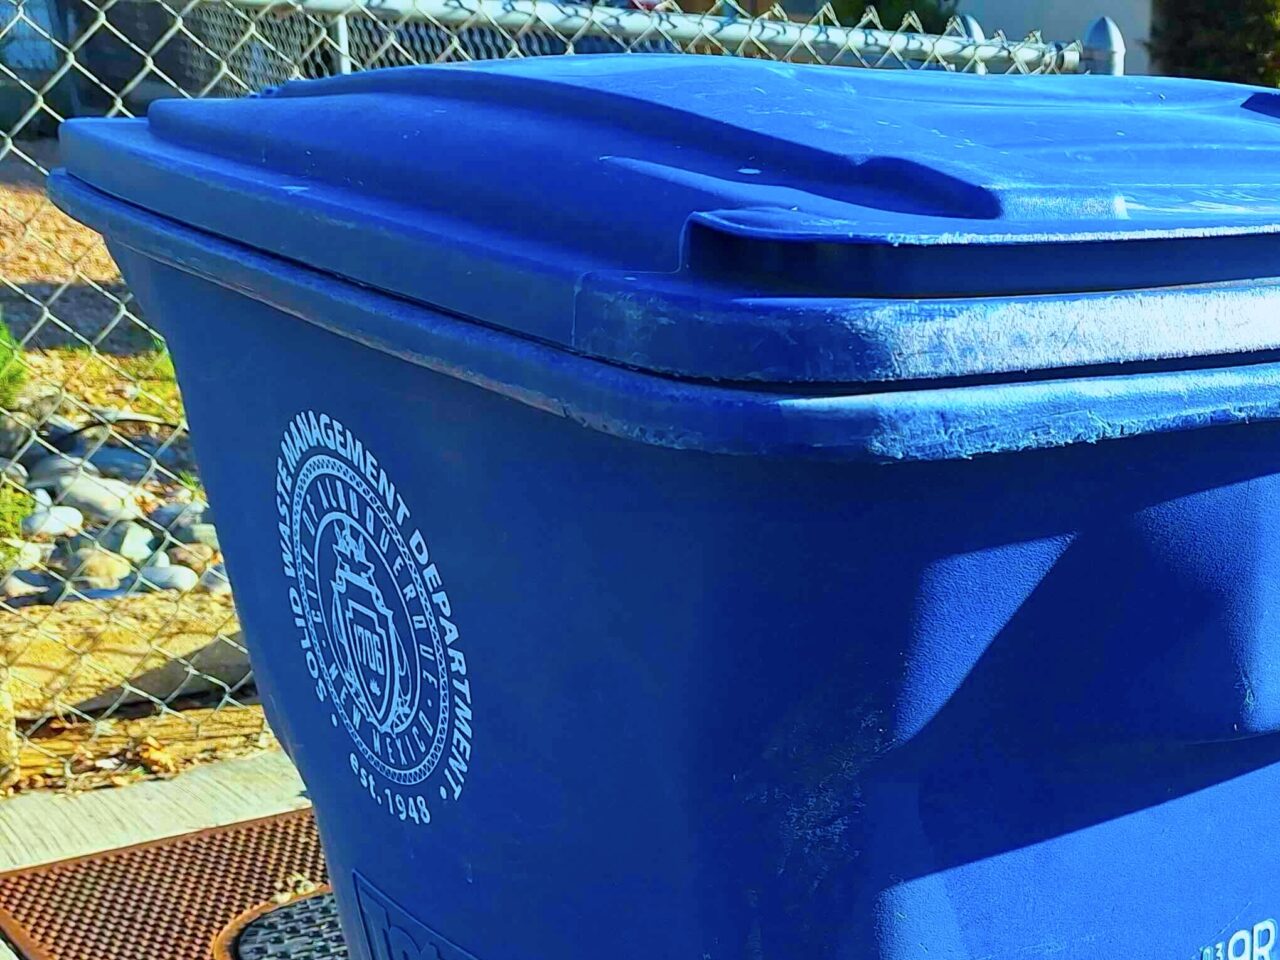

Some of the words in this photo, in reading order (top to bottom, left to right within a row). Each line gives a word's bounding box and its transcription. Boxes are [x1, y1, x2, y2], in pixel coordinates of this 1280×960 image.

[276, 456, 296, 579] WASTE
[280, 409, 411, 526] MANAGEMENT
[302, 493, 319, 536] OF
[301, 544, 322, 624] CITY
[317, 477, 438, 689] ALBUQUERQUE
[288, 587, 328, 702] SOLID
[353, 623, 385, 676] 1706
[408, 528, 473, 801] DEPARTMENT
[328, 662, 361, 731] NEW
[371, 709, 435, 766] MEXICO
